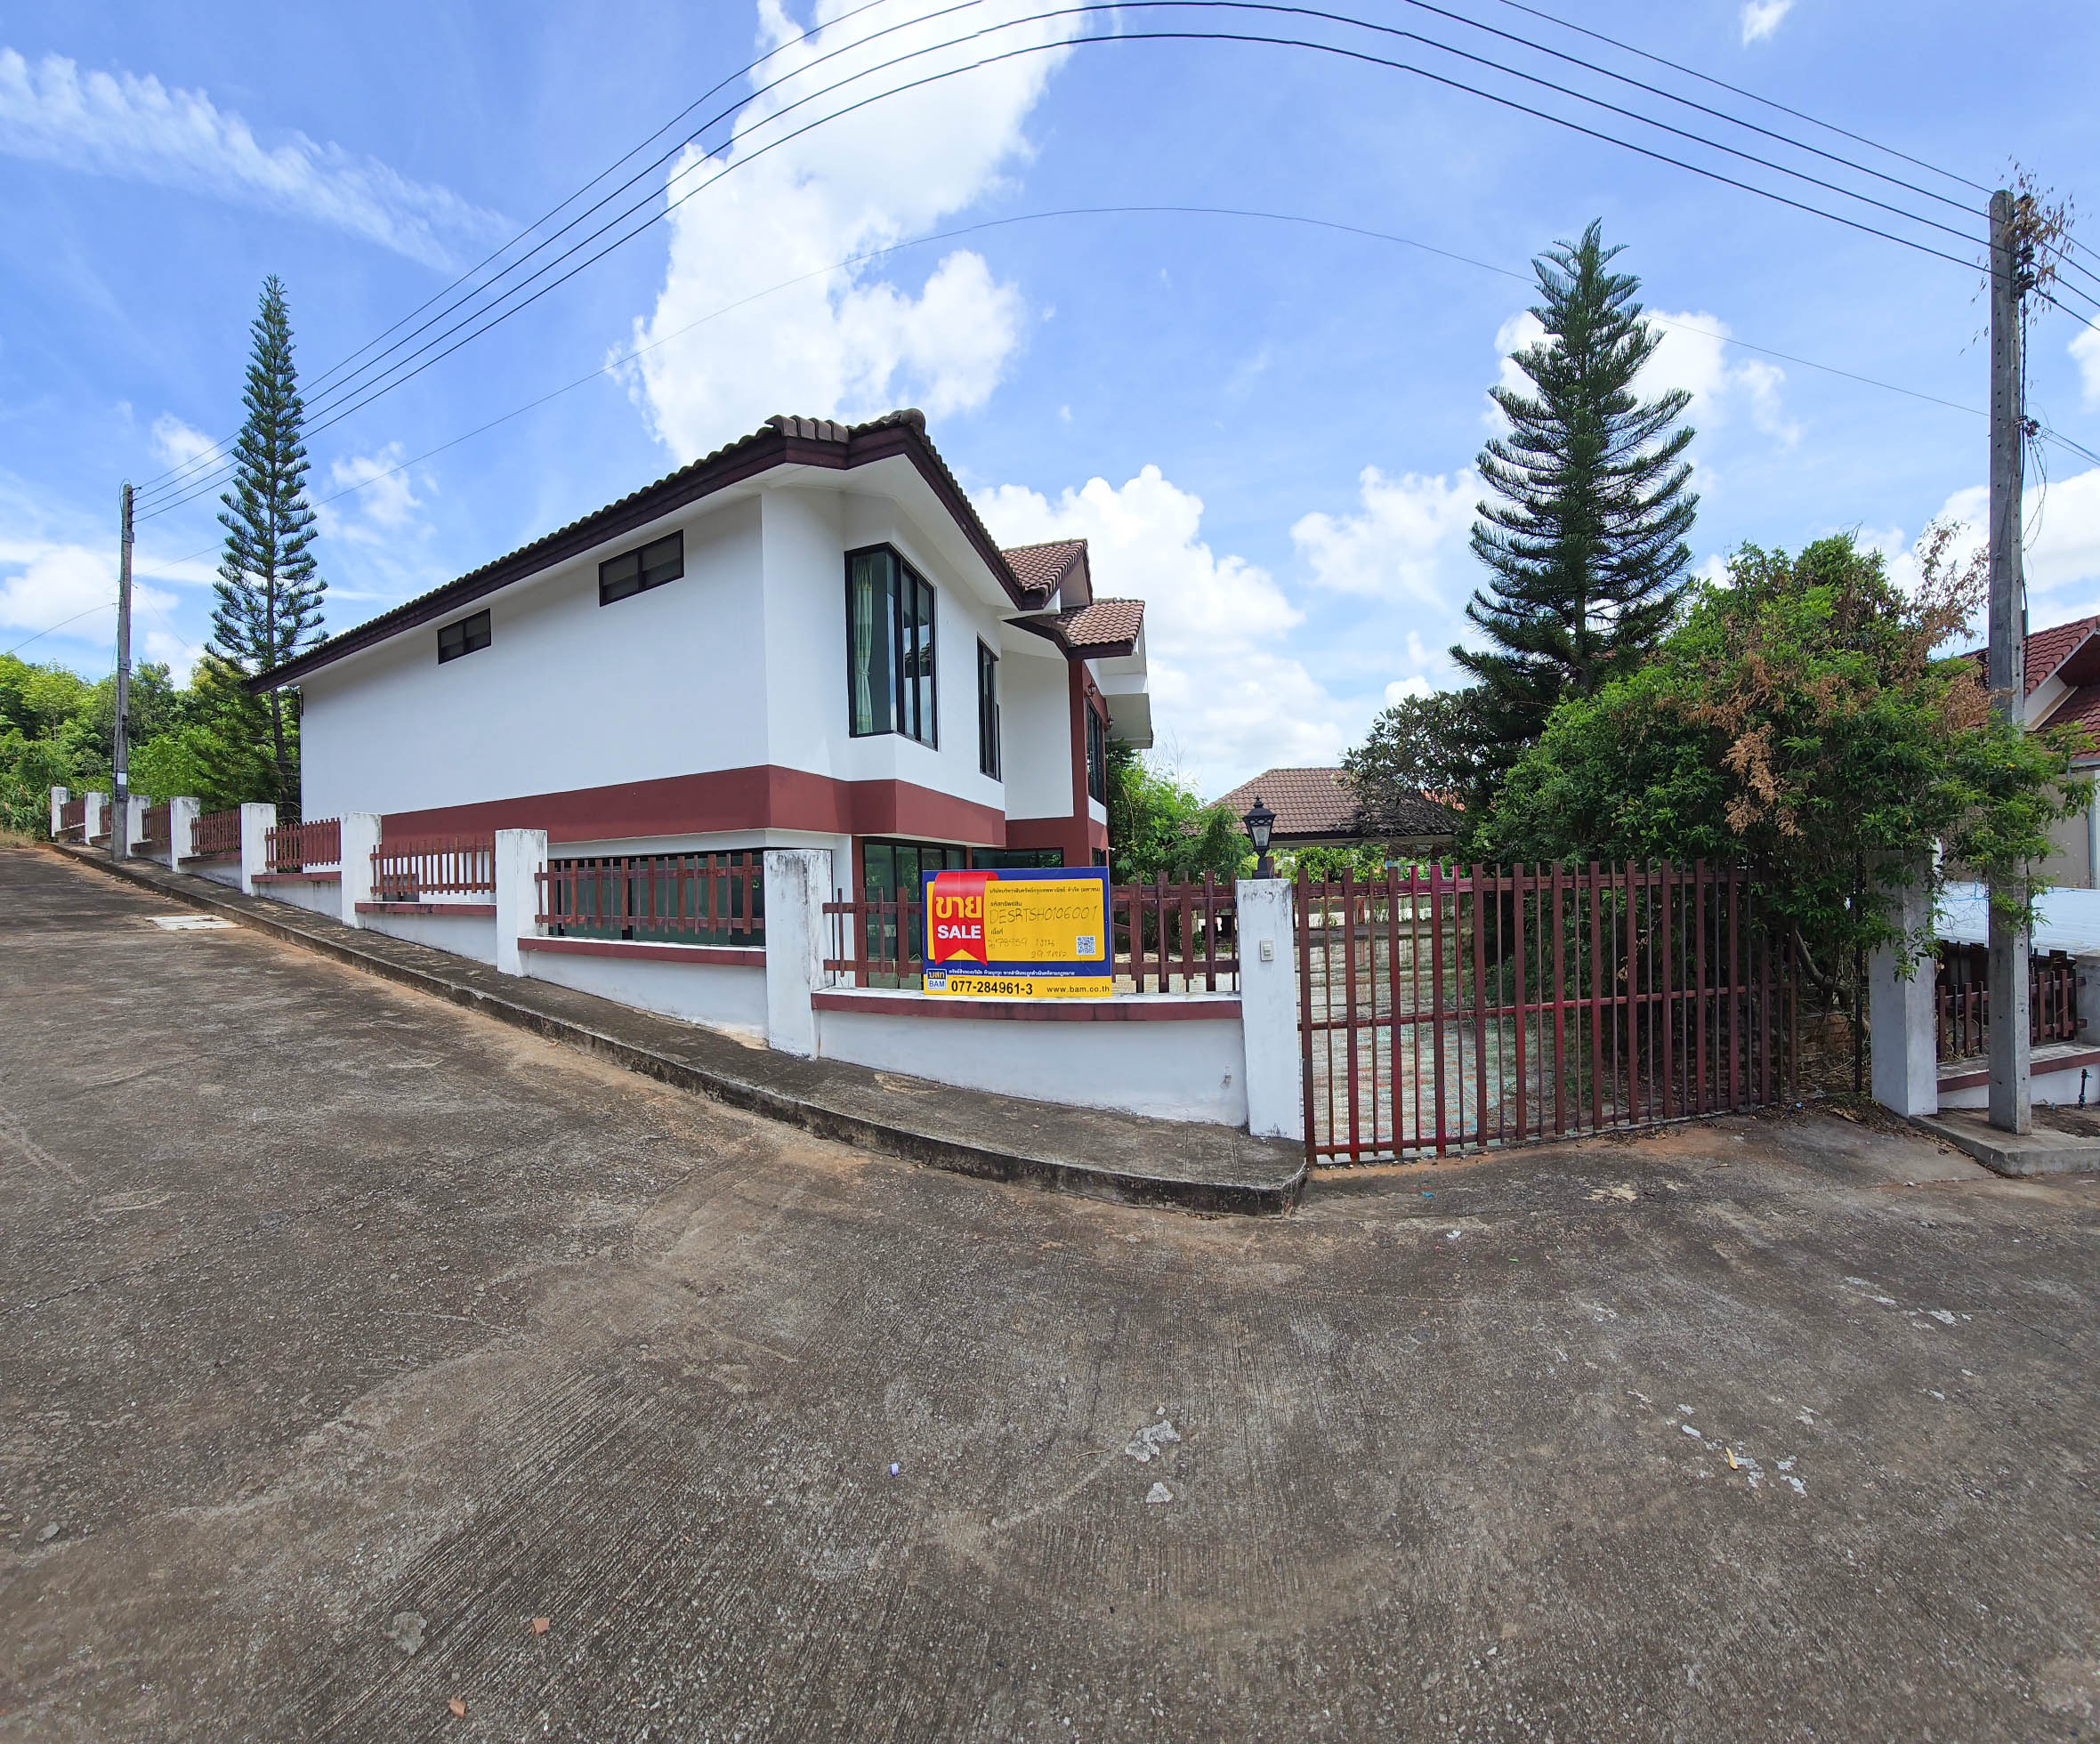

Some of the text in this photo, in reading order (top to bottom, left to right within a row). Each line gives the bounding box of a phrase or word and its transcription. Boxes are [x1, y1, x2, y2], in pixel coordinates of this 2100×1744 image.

[935, 896, 981, 918] ขาย
[937, 924, 981, 940] SALE
[928, 980, 945, 988] BAM
[951, 981, 1110, 995] 077-284961-3 www.bam.co.th
